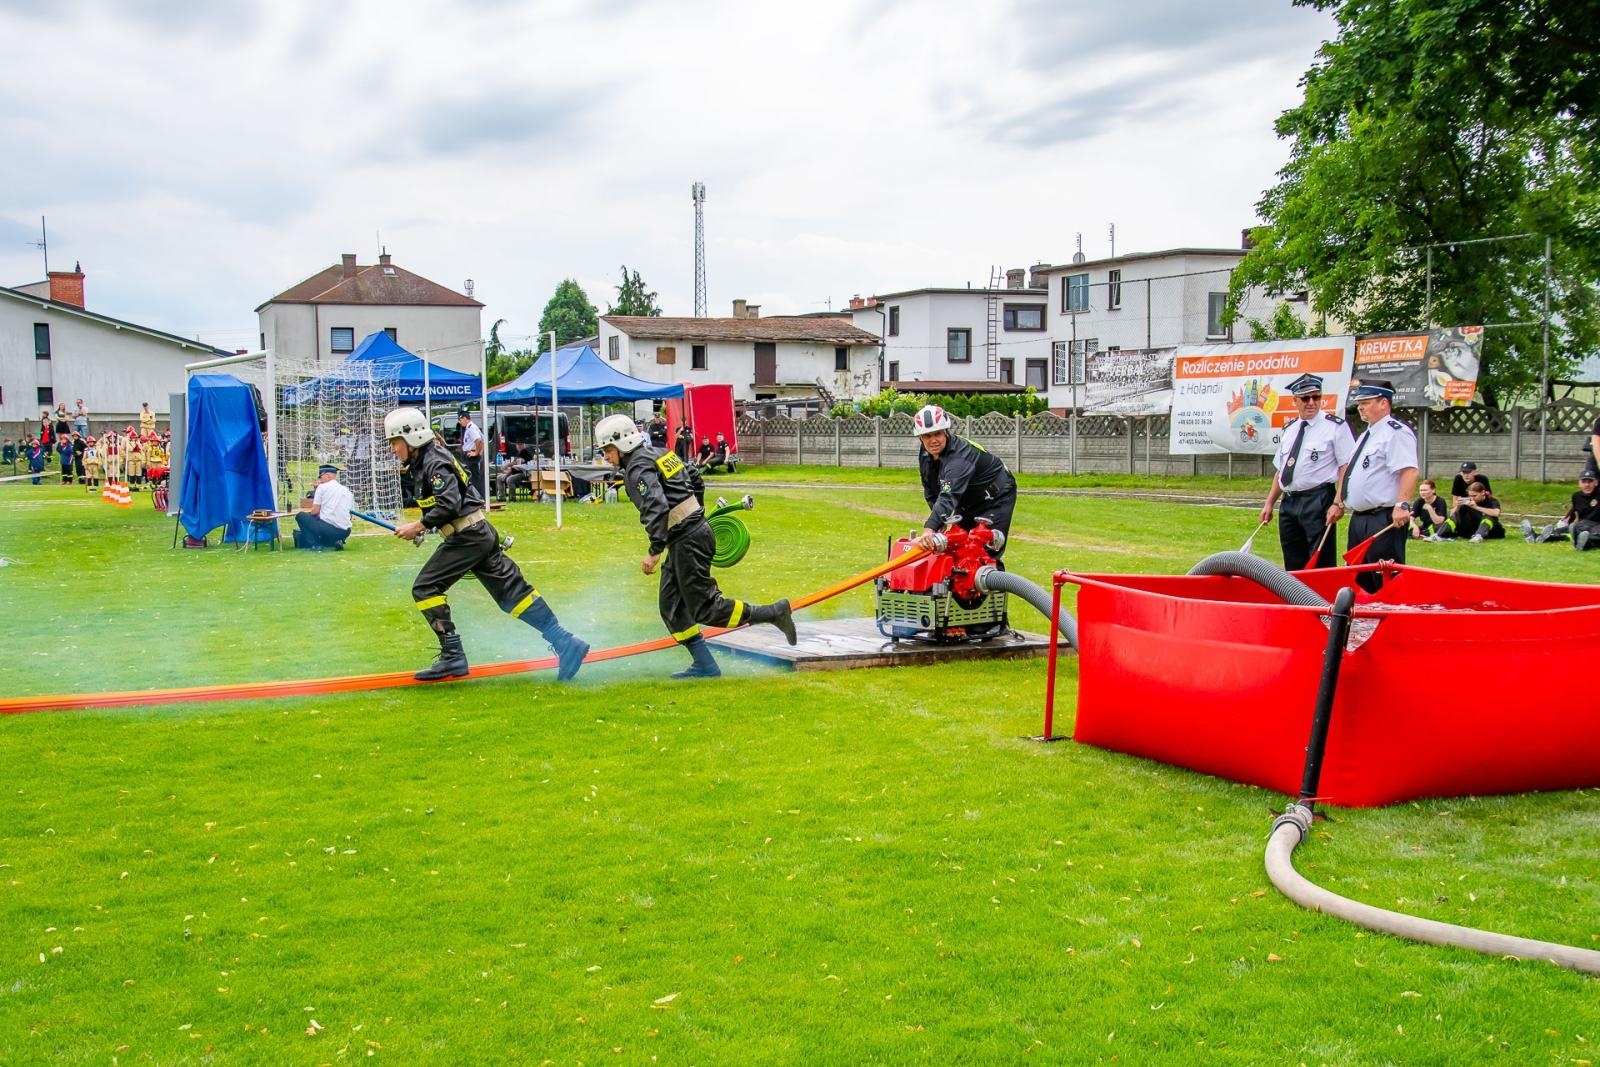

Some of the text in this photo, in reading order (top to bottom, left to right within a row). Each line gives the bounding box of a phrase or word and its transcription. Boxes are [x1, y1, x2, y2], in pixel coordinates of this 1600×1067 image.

[1359, 339, 1423, 355] KREWETKA
[1182, 355, 1299, 374] Rozliczenie podatku
[349, 387, 383, 396] GMINA
[1186, 382, 1223, 395] Holandii
